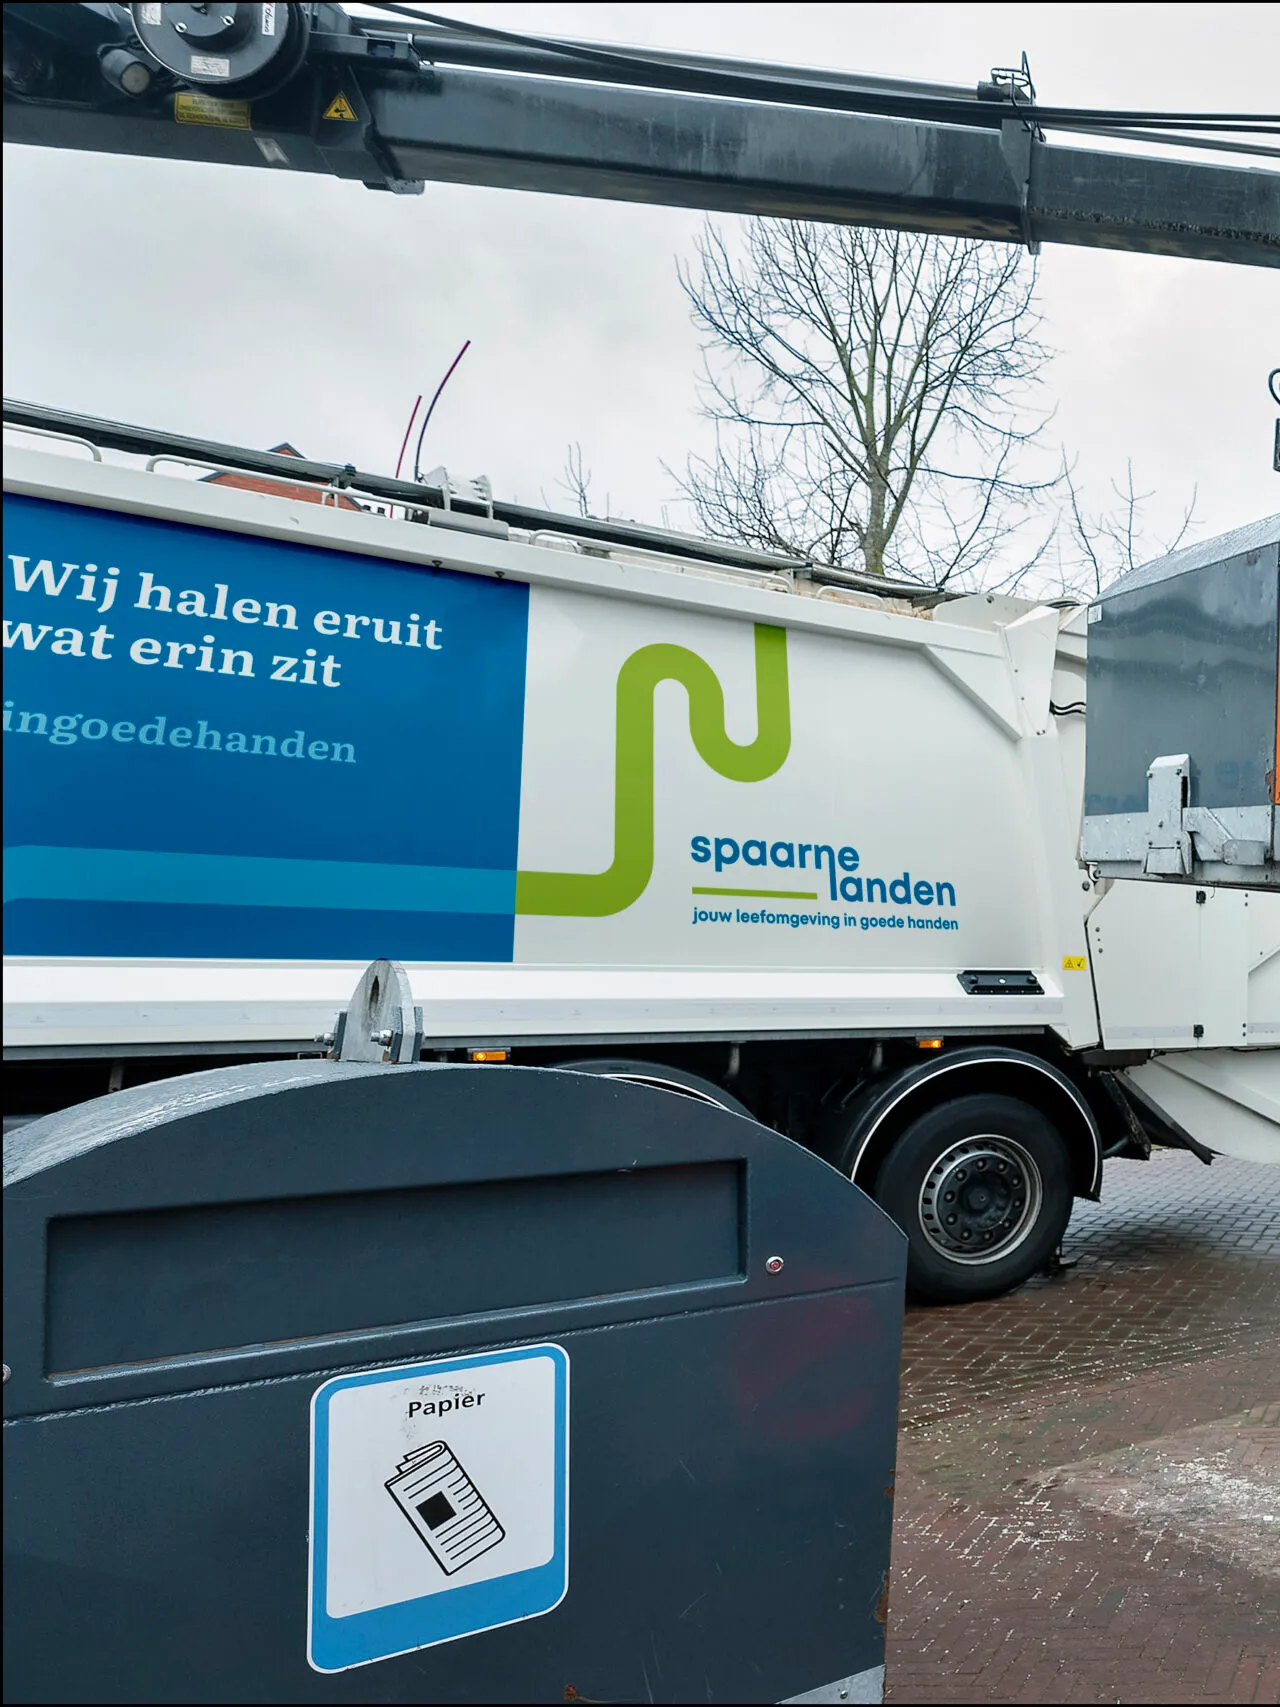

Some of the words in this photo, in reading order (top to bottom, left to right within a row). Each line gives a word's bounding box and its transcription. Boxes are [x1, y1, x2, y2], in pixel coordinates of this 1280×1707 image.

[7, 554, 120, 613] Wij
[133, 571, 299, 630] halen
[313, 610, 443, 650] eruit
[3, 619, 115, 660] wat
[129, 634, 255, 678] erin
[270, 648, 342, 688] zit
[3, 700, 357, 763] ingoedehanden
[690, 835, 860, 873] spaarne
[829, 868, 957, 907] landen
[691, 906, 733, 925] jouw
[735, 908, 841, 930] leefomgeving
[843, 912, 857, 927] in
[859, 914, 905, 931] goede
[907, 915, 959, 931] handen
[408, 1393, 486, 1418] Papier
